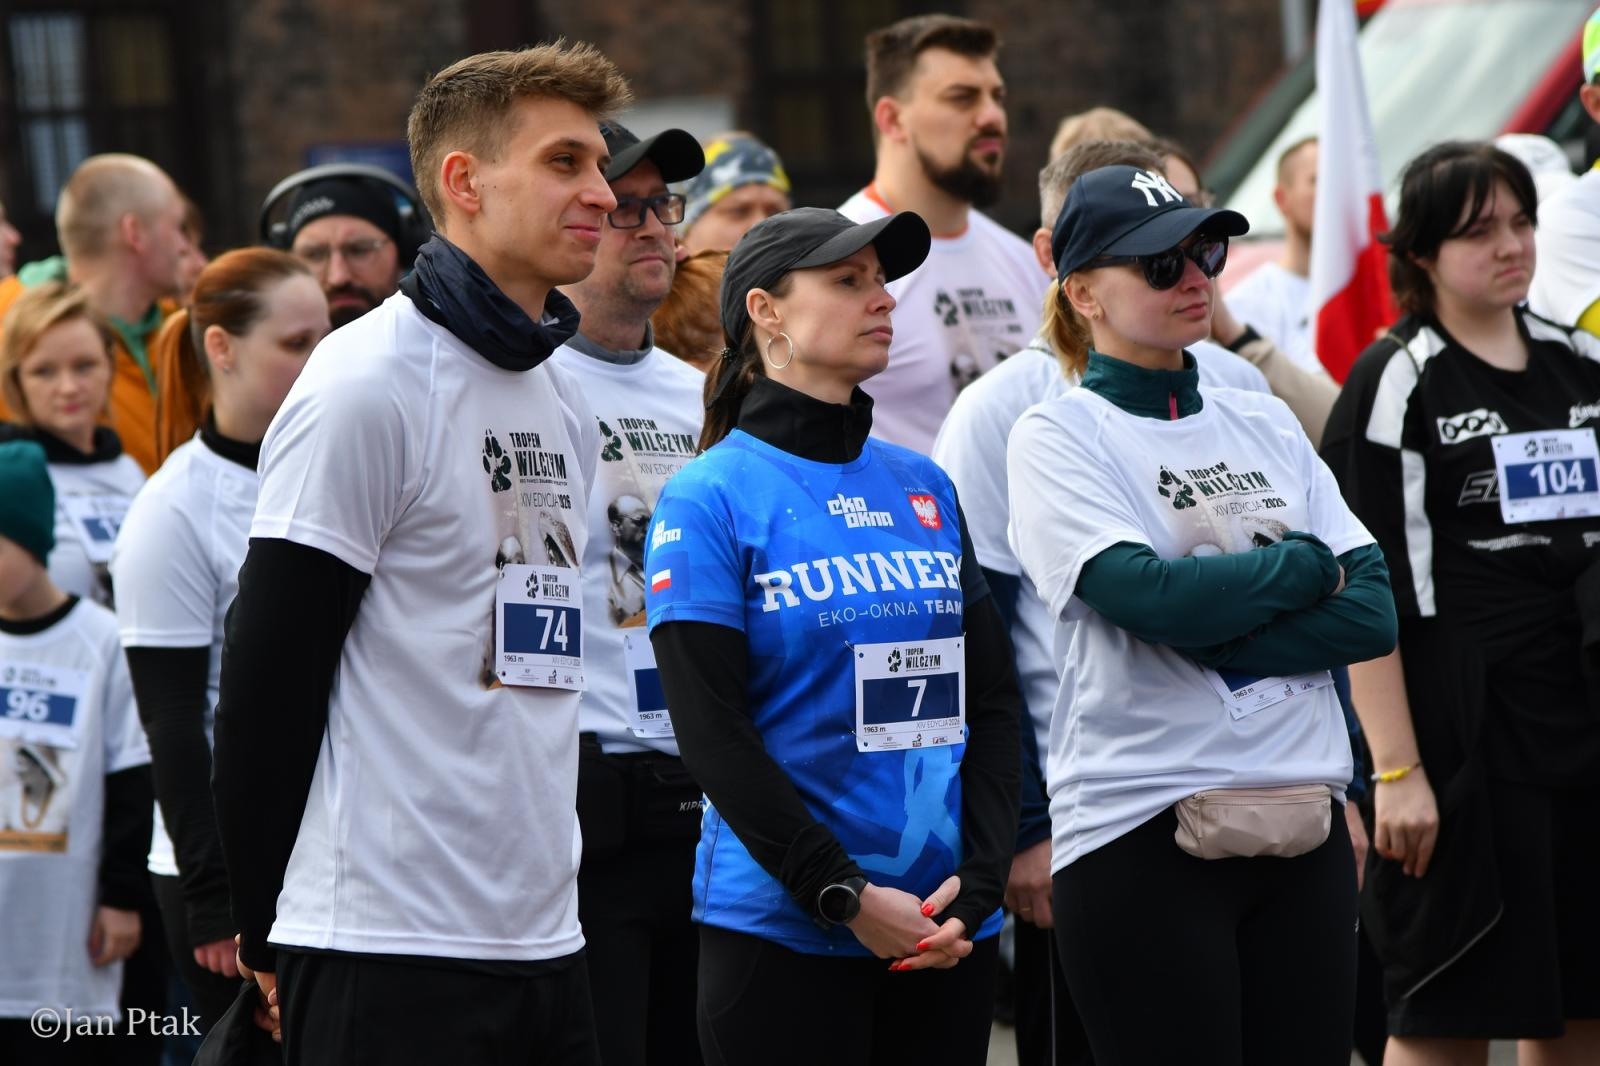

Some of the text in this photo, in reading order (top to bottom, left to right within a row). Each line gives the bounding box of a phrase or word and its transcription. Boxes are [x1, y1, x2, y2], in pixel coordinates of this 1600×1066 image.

[617, 417, 658, 431] TROPEM
[509, 432, 542, 449] TROPEM
[624, 432, 697, 454] WILCZYM
[515, 450, 567, 479] WILCZYM
[653, 463, 682, 475] EDYC
[1185, 461, 1229, 480] TROPEM
[1195, 471, 1273, 497] WILCZYM
[1529, 460, 1586, 496] 104
[520, 492, 532, 507] XIV
[533, 492, 558, 508] EDYCJA
[1212, 497, 1287, 517] XIV EDYCJA 2026
[542, 583, 570, 598] WILCZYM
[754, 551, 962, 613] RUNNER
[923, 599, 962, 616] TEAM
[535, 608, 568, 652] 74
[504, 655, 517, 663] 1963
[905, 647, 924, 656] TROPEM
[905, 655, 941, 669] WILCZYM
[7, 689, 49, 722] 96
[907, 678, 928, 717] 7
[639, 712, 654, 720] 1963
